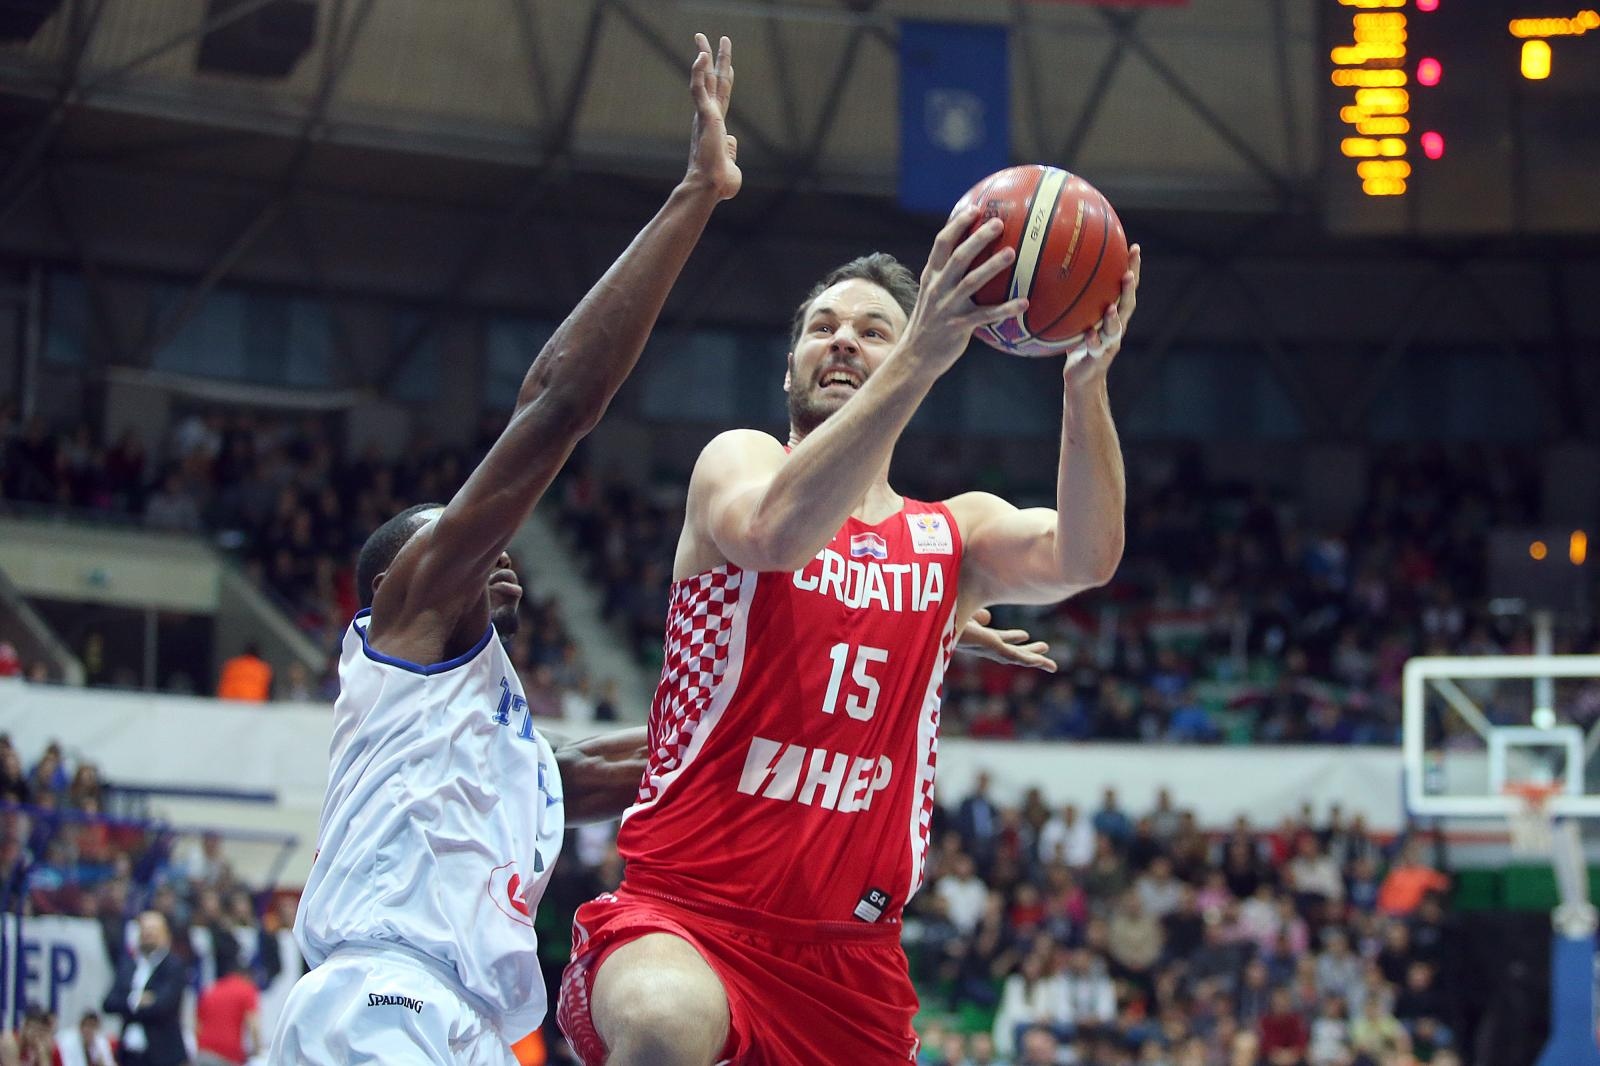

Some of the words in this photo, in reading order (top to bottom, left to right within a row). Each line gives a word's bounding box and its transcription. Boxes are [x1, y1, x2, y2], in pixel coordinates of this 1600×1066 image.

[792, 547, 944, 612] CROATIA
[821, 642, 889, 722] 15
[797, 747, 893, 813] HEP
[869, 890, 886, 907] 54
[367, 992, 424, 1014] SPALDING
